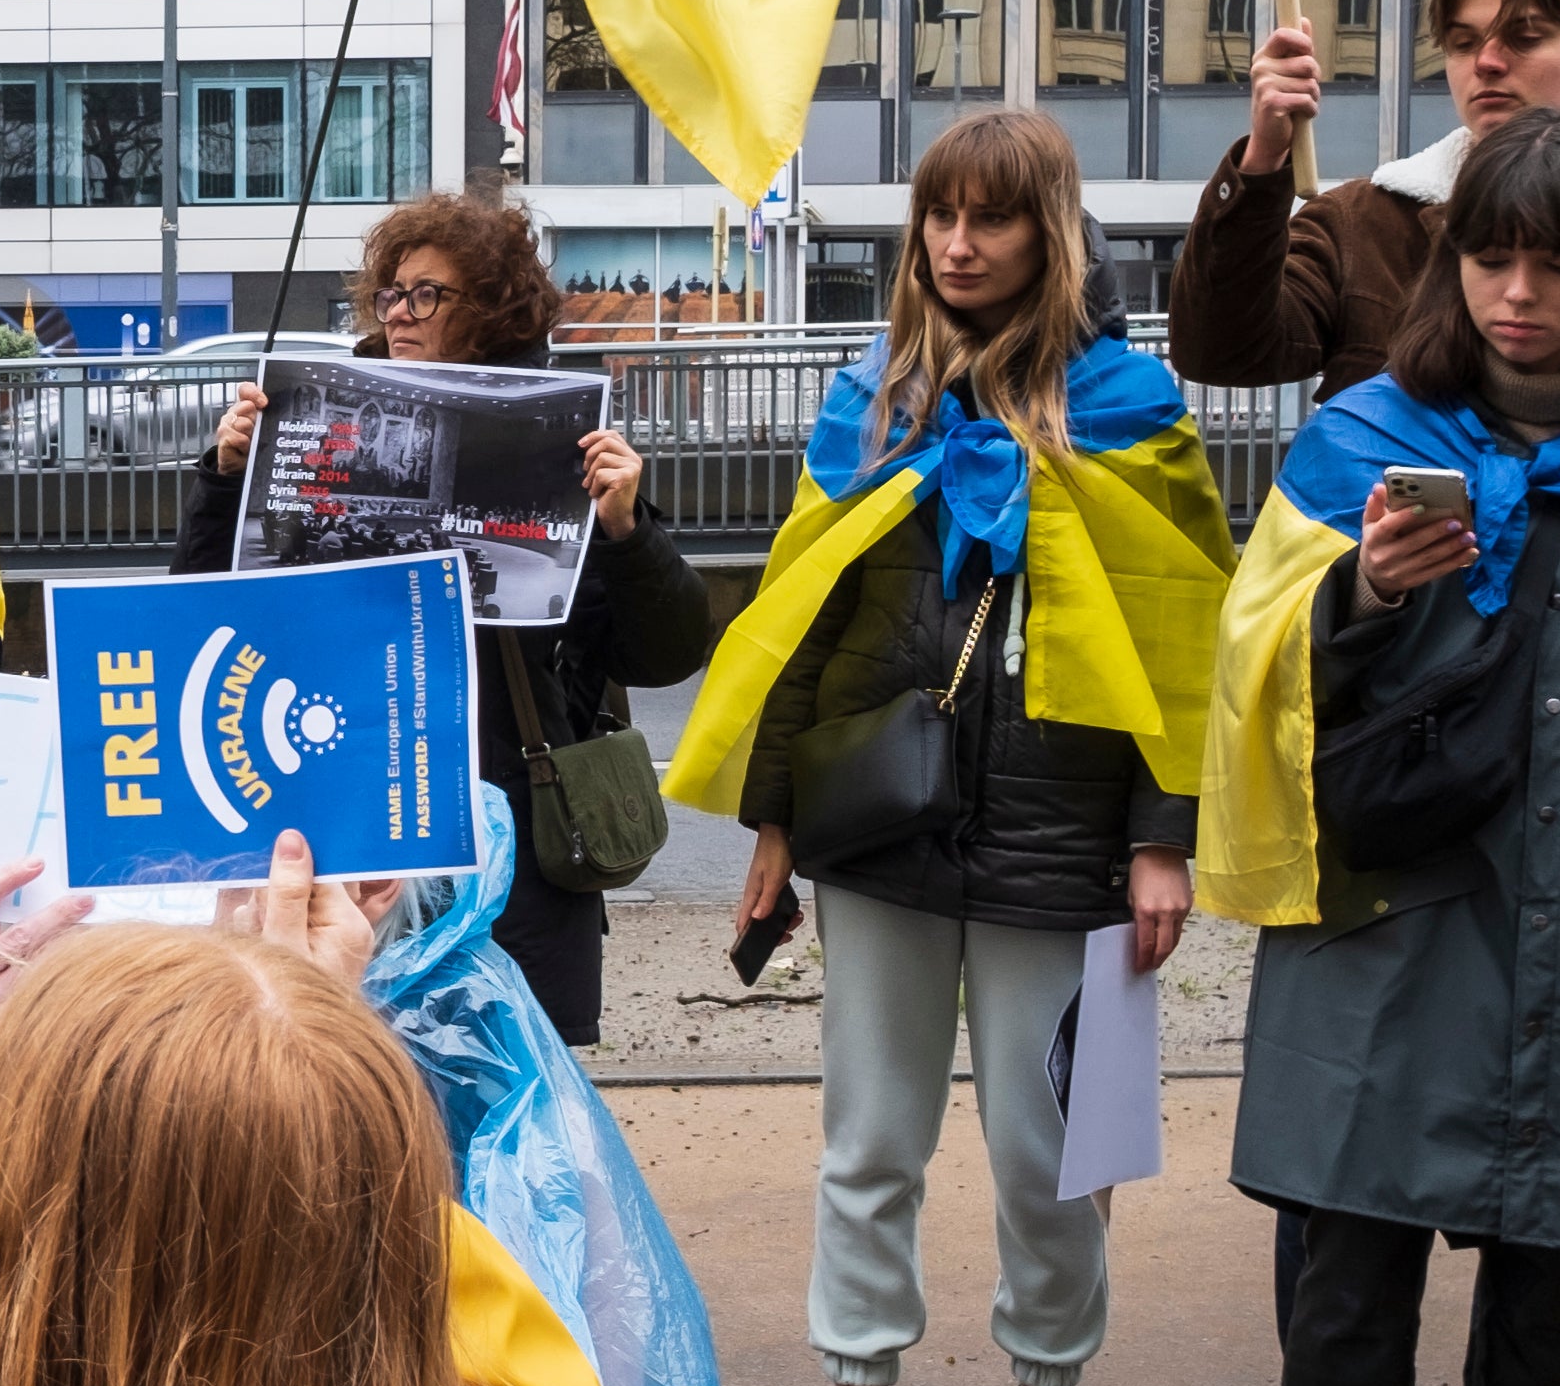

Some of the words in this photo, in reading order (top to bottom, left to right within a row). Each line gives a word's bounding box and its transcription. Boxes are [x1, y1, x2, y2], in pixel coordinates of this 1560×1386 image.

[276, 437, 320, 451] Georgia
[278, 421, 327, 433] Moldova
[272, 468, 315, 480] Ukraine
[318, 471, 350, 483] 2014
[274, 453, 301, 466] Syria
[267, 499, 312, 512] Ukraine
[269, 484, 297, 497] Syria
[441, 509, 580, 541] #unrussiaUN
[386, 643, 397, 692] Union
[408, 570, 427, 730] #StandWithUkraine
[97, 650, 162, 817] FREE
[217, 643, 272, 810] UKRAINE
[387, 696, 402, 778] European
[414, 734, 430, 839] PASSWORD:
[390, 782, 403, 840] NAME:
